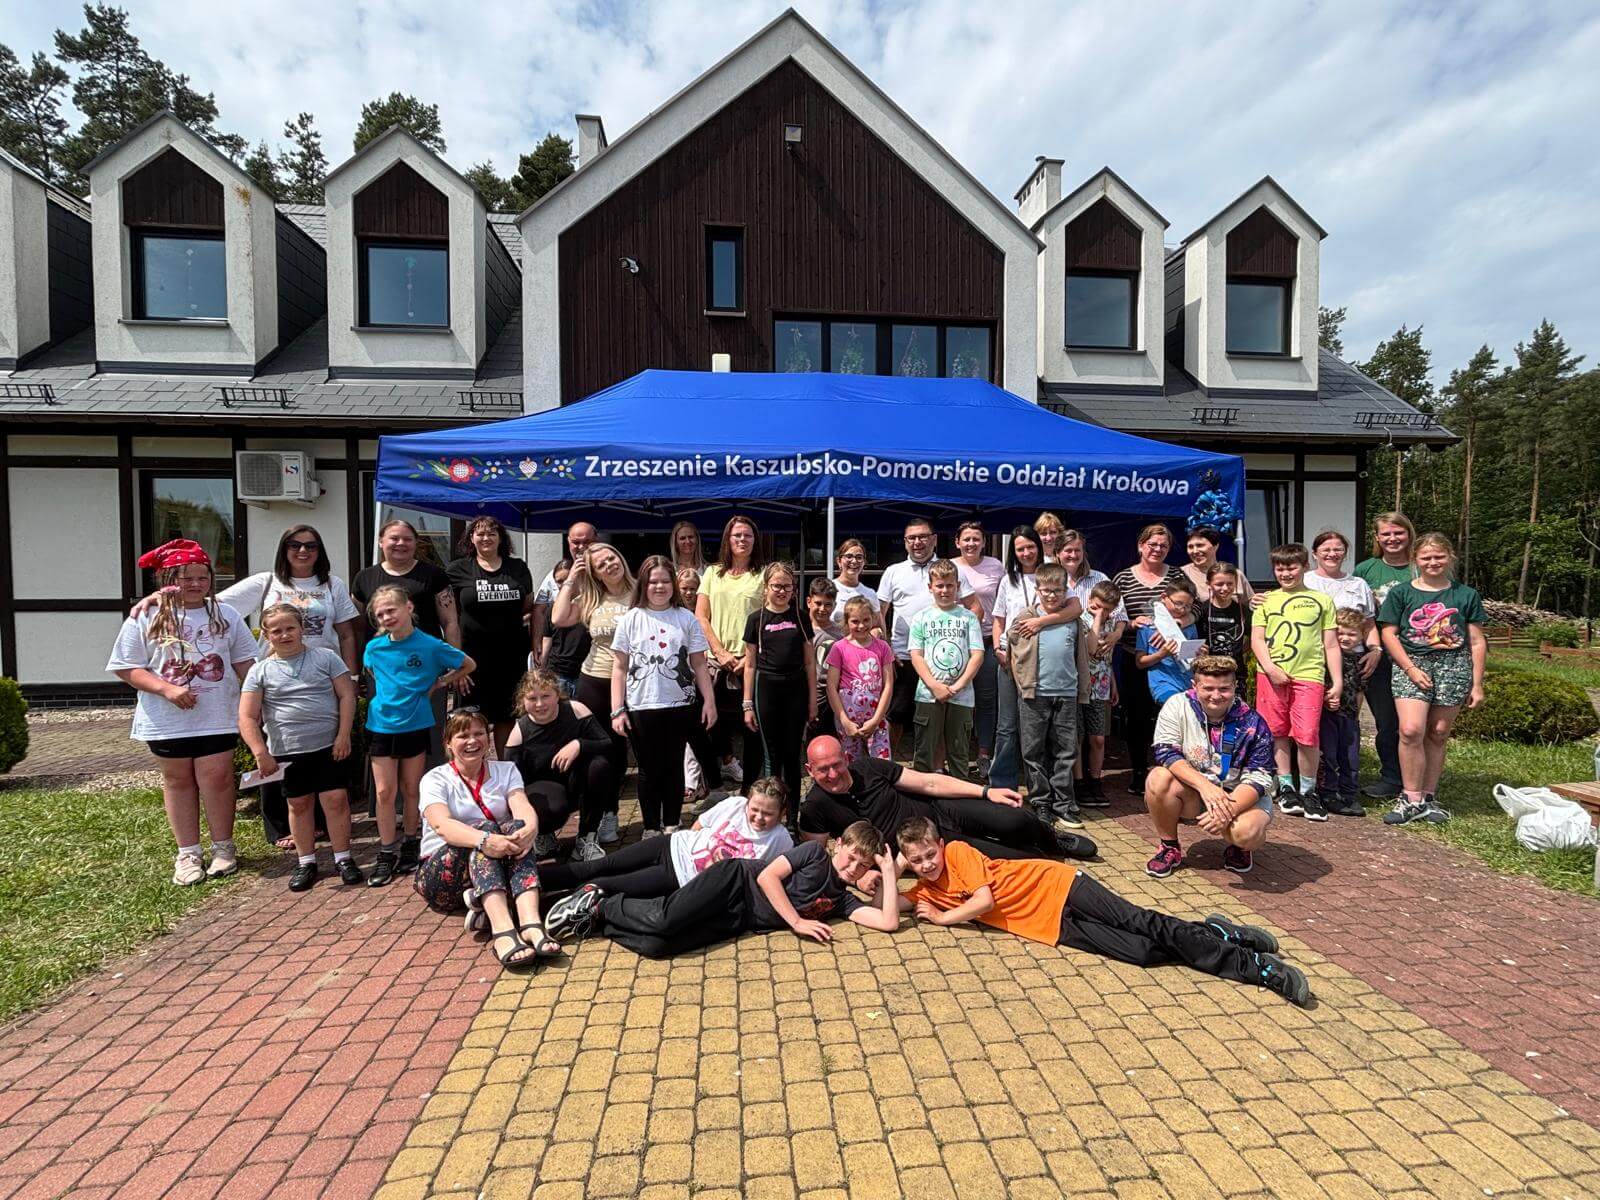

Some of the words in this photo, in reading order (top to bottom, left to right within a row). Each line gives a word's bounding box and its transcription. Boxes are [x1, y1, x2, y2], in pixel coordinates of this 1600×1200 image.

[584, 454, 717, 477] Zrzeszenie
[725, 452, 989, 483] Kaszubsko-Pomorskie
[996, 463, 1086, 488] Oddział
[1092, 469, 1189, 496] Krokowa
[476, 583, 492, 592] NOT
[494, 583, 509, 591] FOR
[479, 590, 519, 600] EVERYONE
[926, 628, 967, 639] XPRESSION
